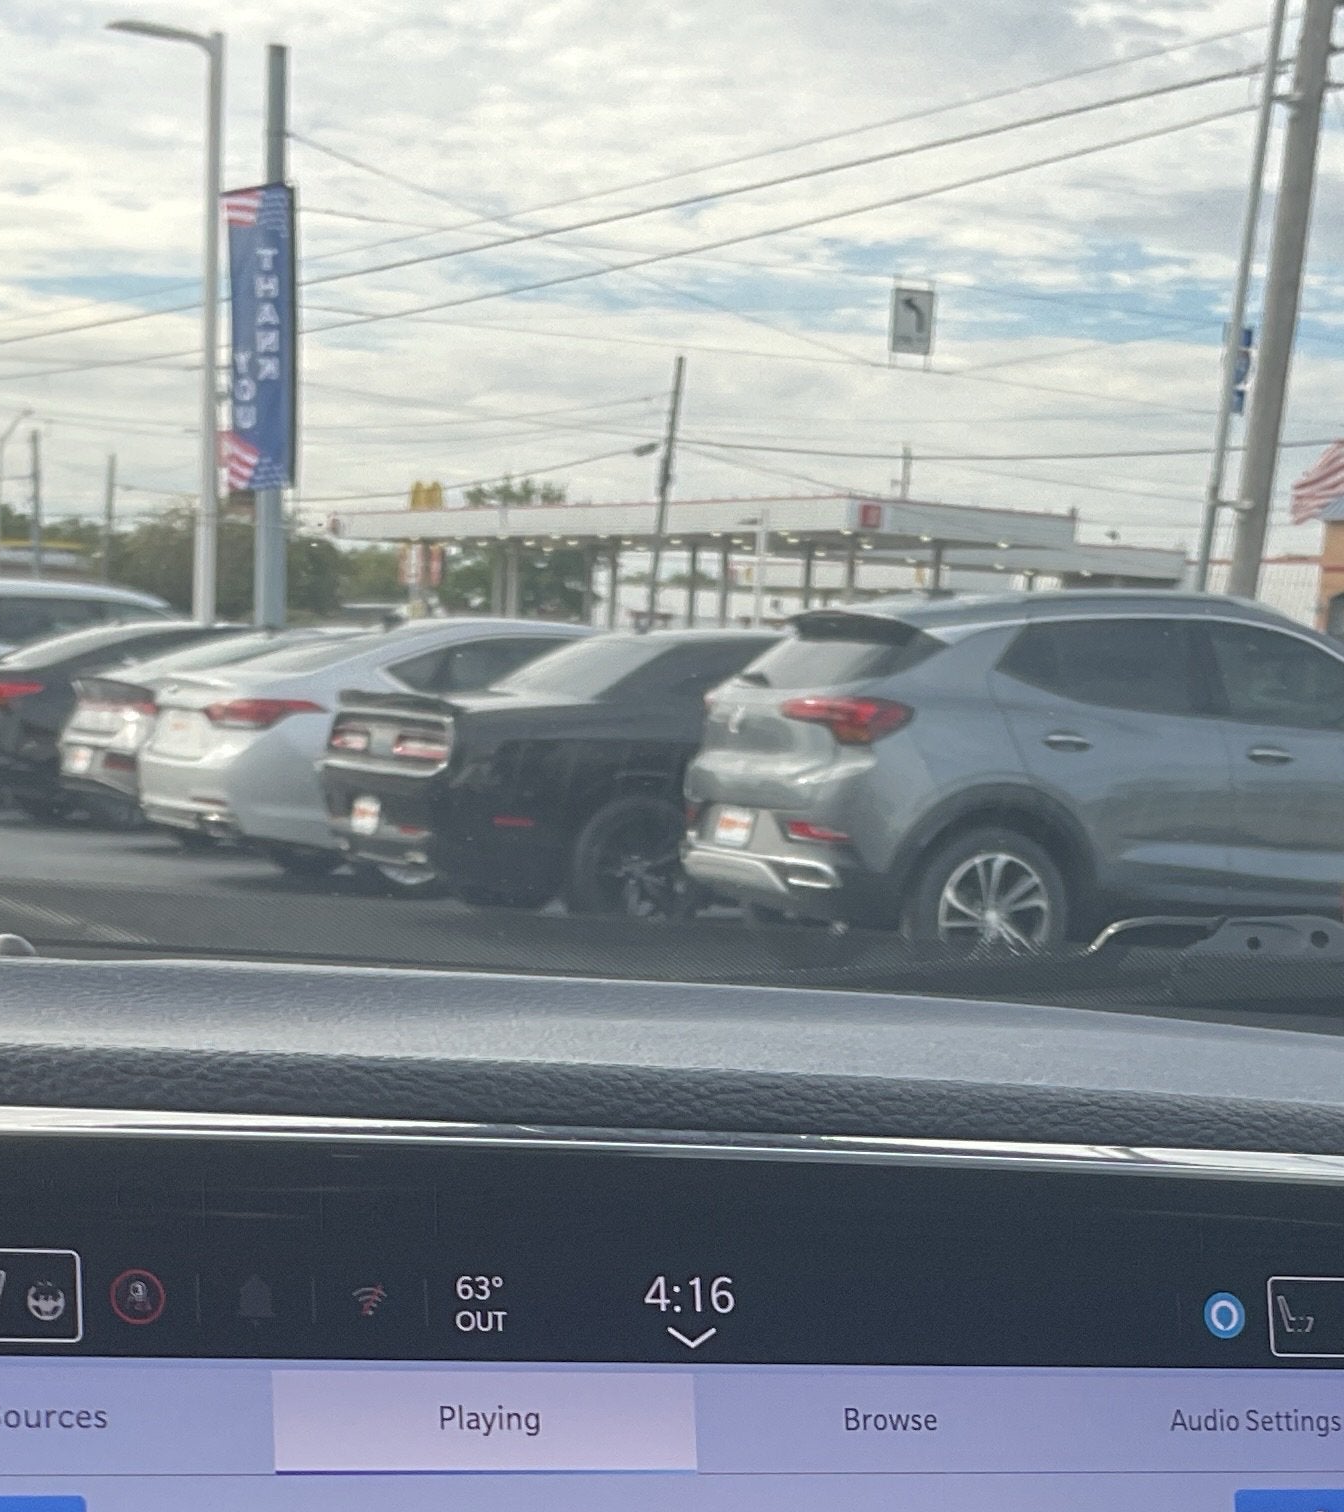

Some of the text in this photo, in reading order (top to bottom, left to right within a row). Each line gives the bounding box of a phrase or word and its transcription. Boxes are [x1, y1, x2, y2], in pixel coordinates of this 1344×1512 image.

[456, 1275, 504, 1301] 63°
[644, 1276, 735, 1314] 4:16
[456, 1311, 507, 1332] OUT
[439, 1404, 541, 1437] Playing
[844, 1407, 938, 1432] Browse
[1170, 1408, 1342, 1438] Audio Settings
